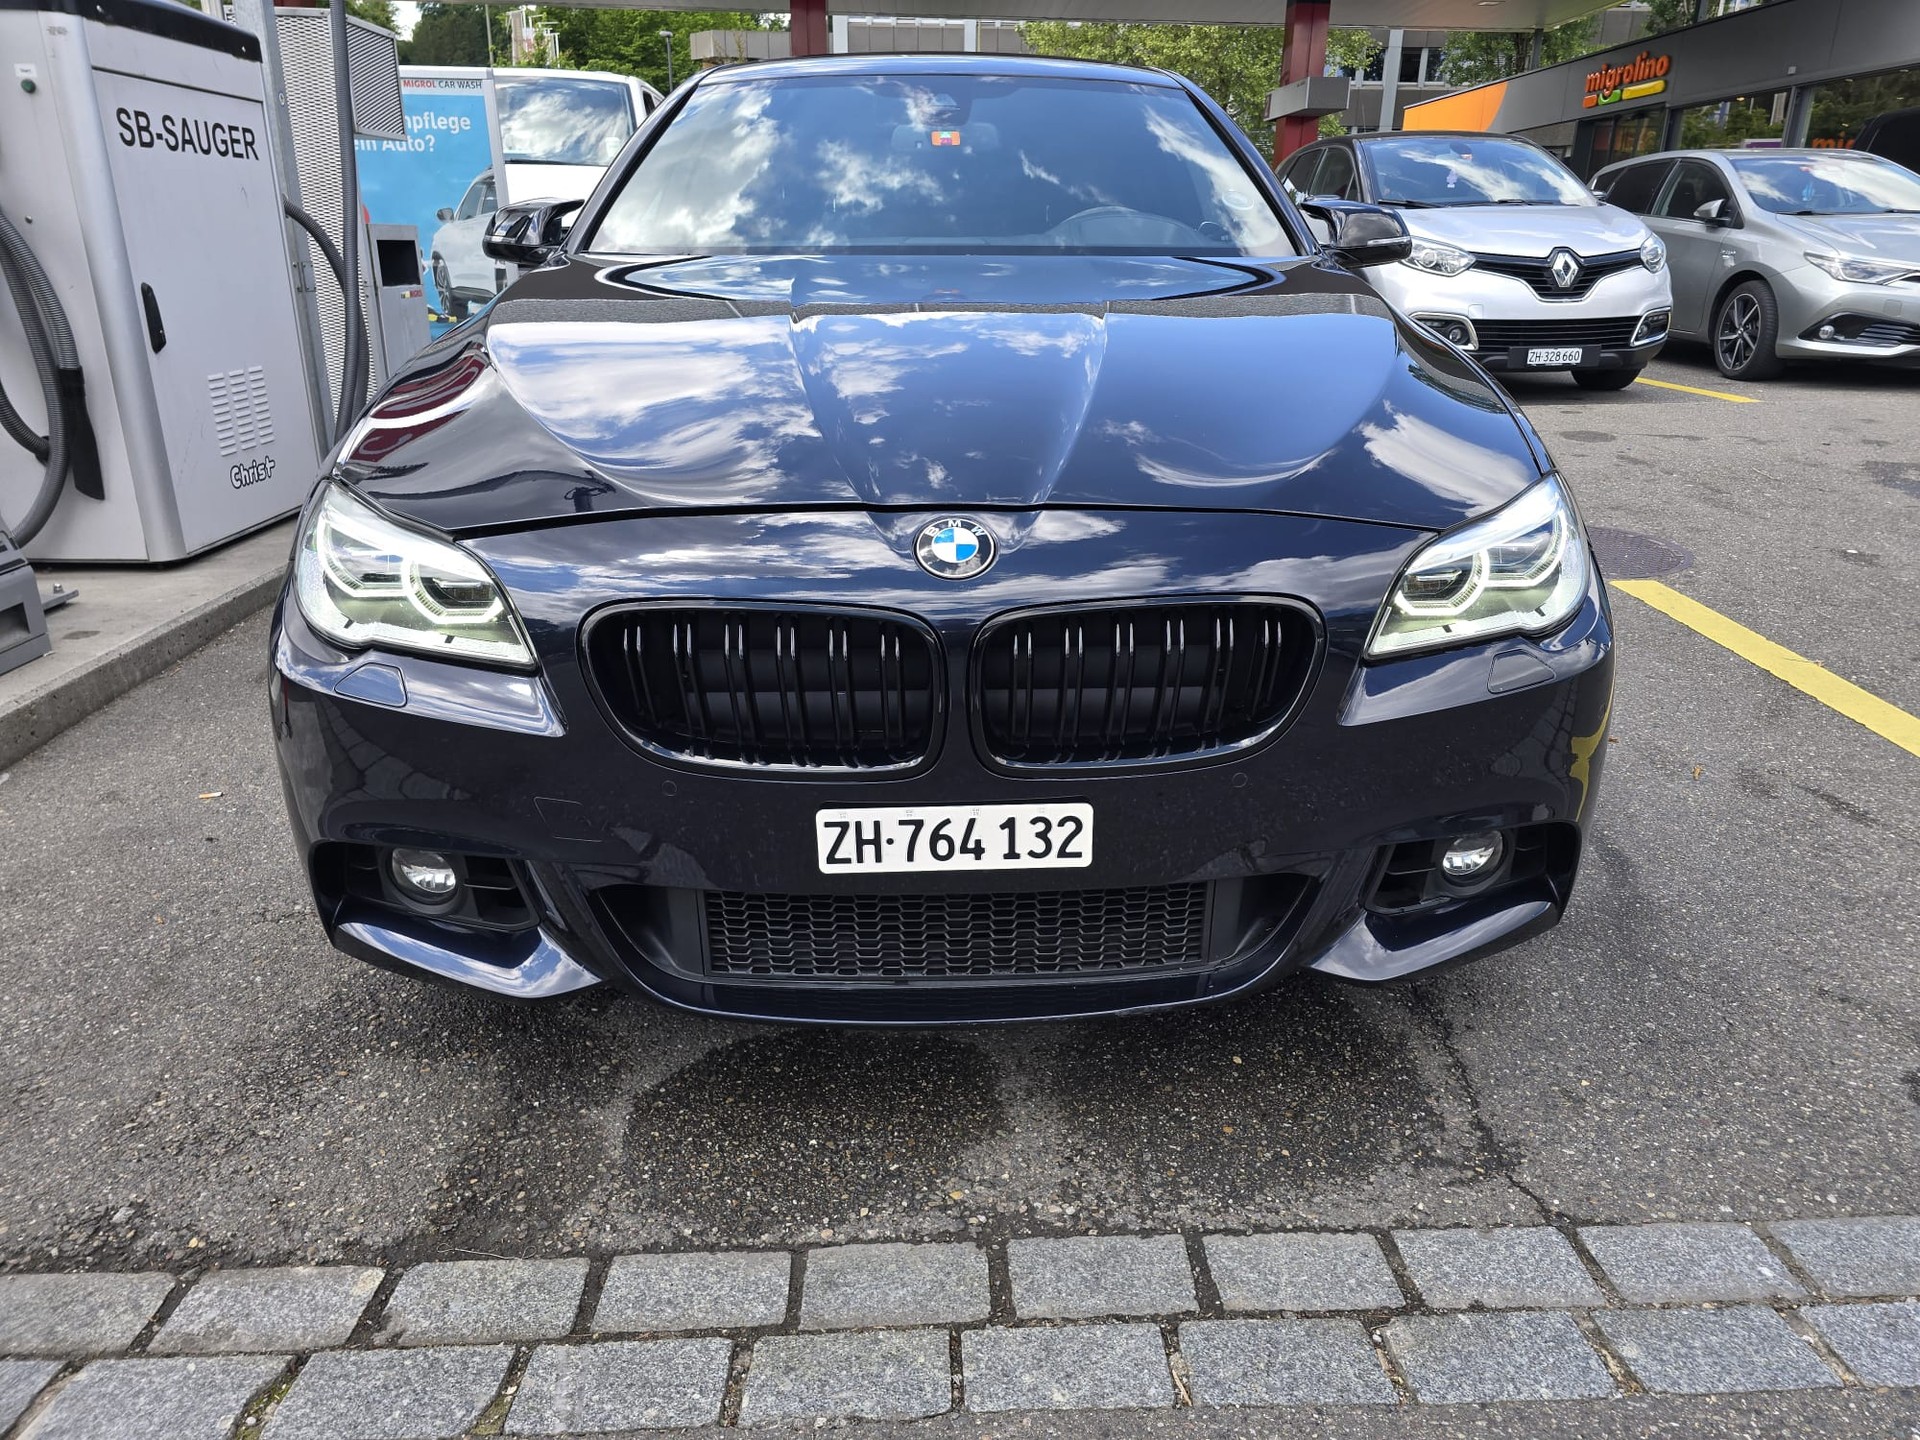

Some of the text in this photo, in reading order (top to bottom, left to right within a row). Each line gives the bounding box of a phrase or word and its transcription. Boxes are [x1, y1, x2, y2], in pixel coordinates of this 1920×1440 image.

[403, 80, 482, 90] MIGROL CAR WASH
[1584, 51, 1669, 97] migrolino
[116, 107, 260, 161] SB-SAUGER
[381, 135, 436, 152] Auto?
[1562, 350, 1580, 362] 660
[230, 455, 276, 489] Christ
[924, 519, 987, 538] BMW
[999, 815, 1084, 860] 132
